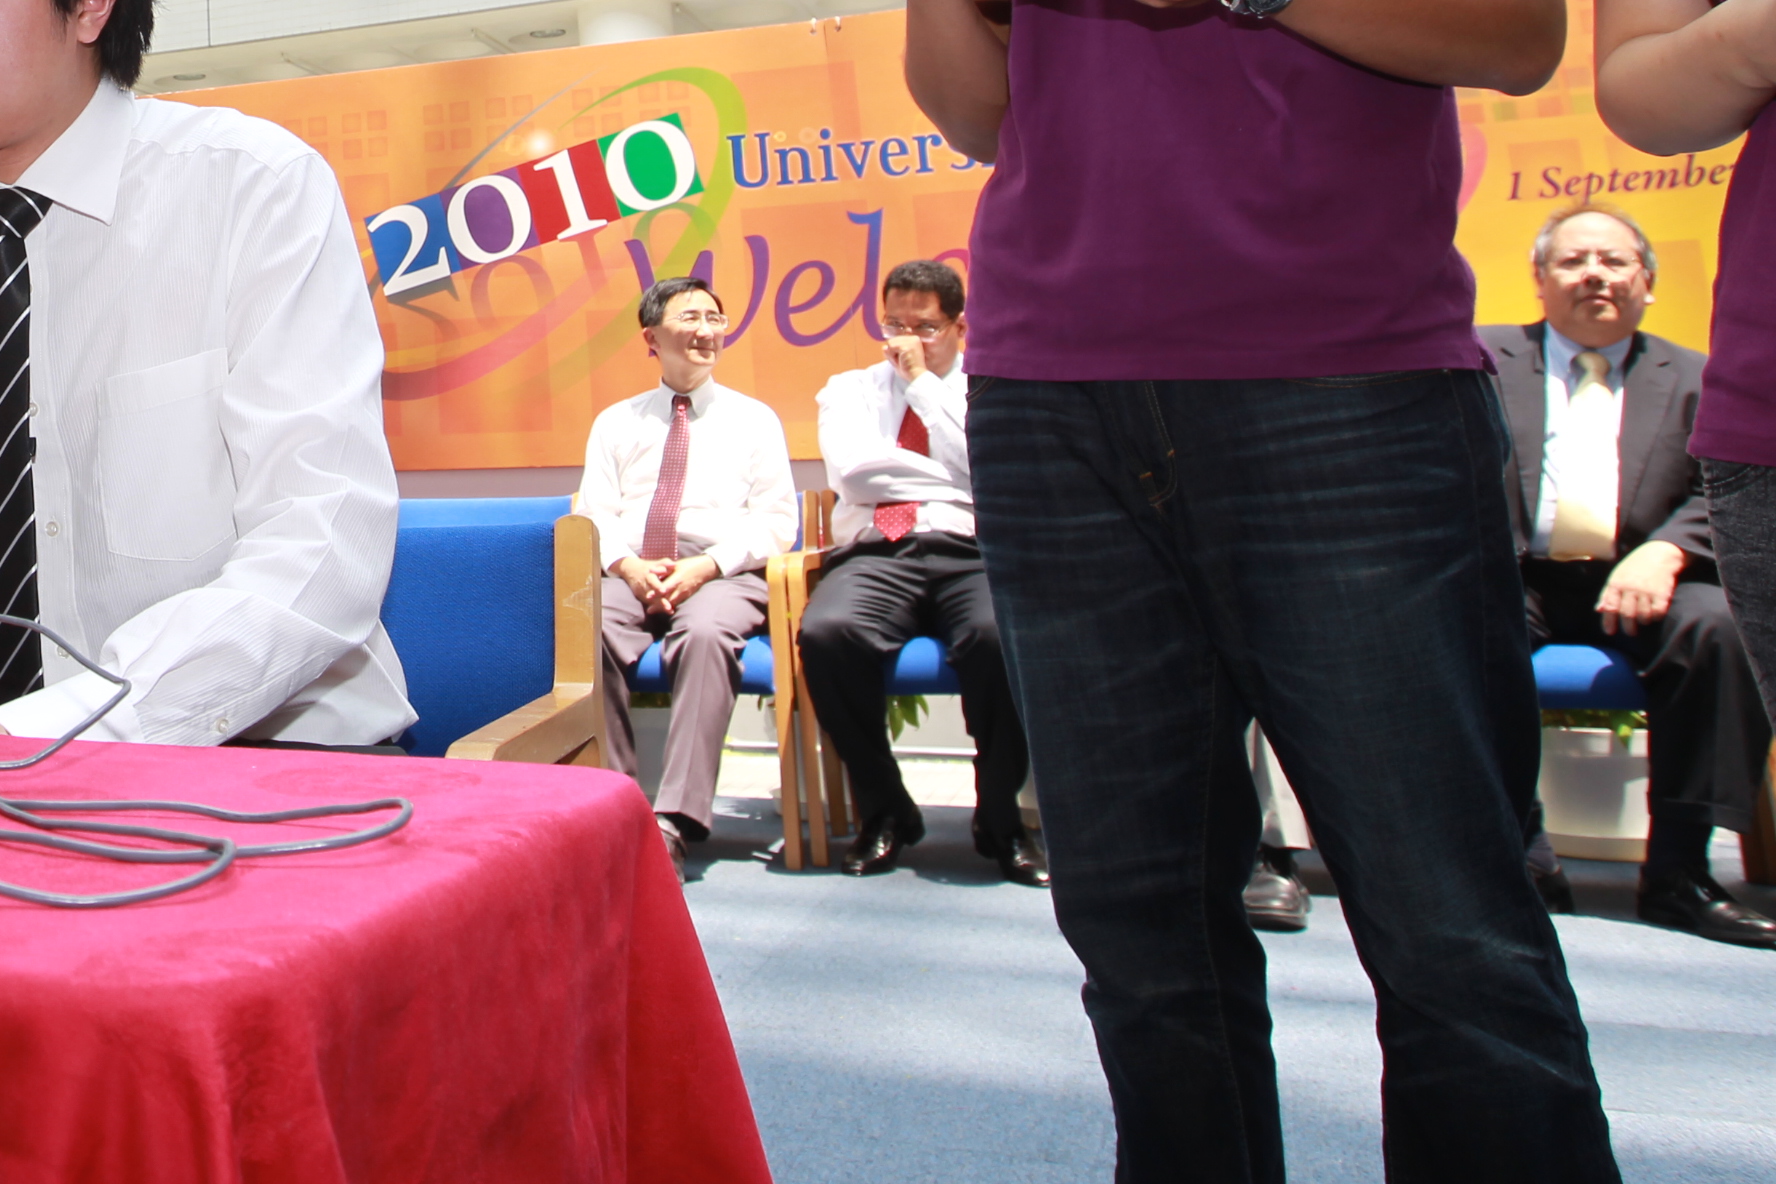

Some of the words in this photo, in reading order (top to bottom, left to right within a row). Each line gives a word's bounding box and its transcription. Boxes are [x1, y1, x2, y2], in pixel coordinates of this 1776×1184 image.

[726, 128, 995, 189] Univer
[1507, 172, 1521, 201] 1
[366, 118, 697, 297] 2010
